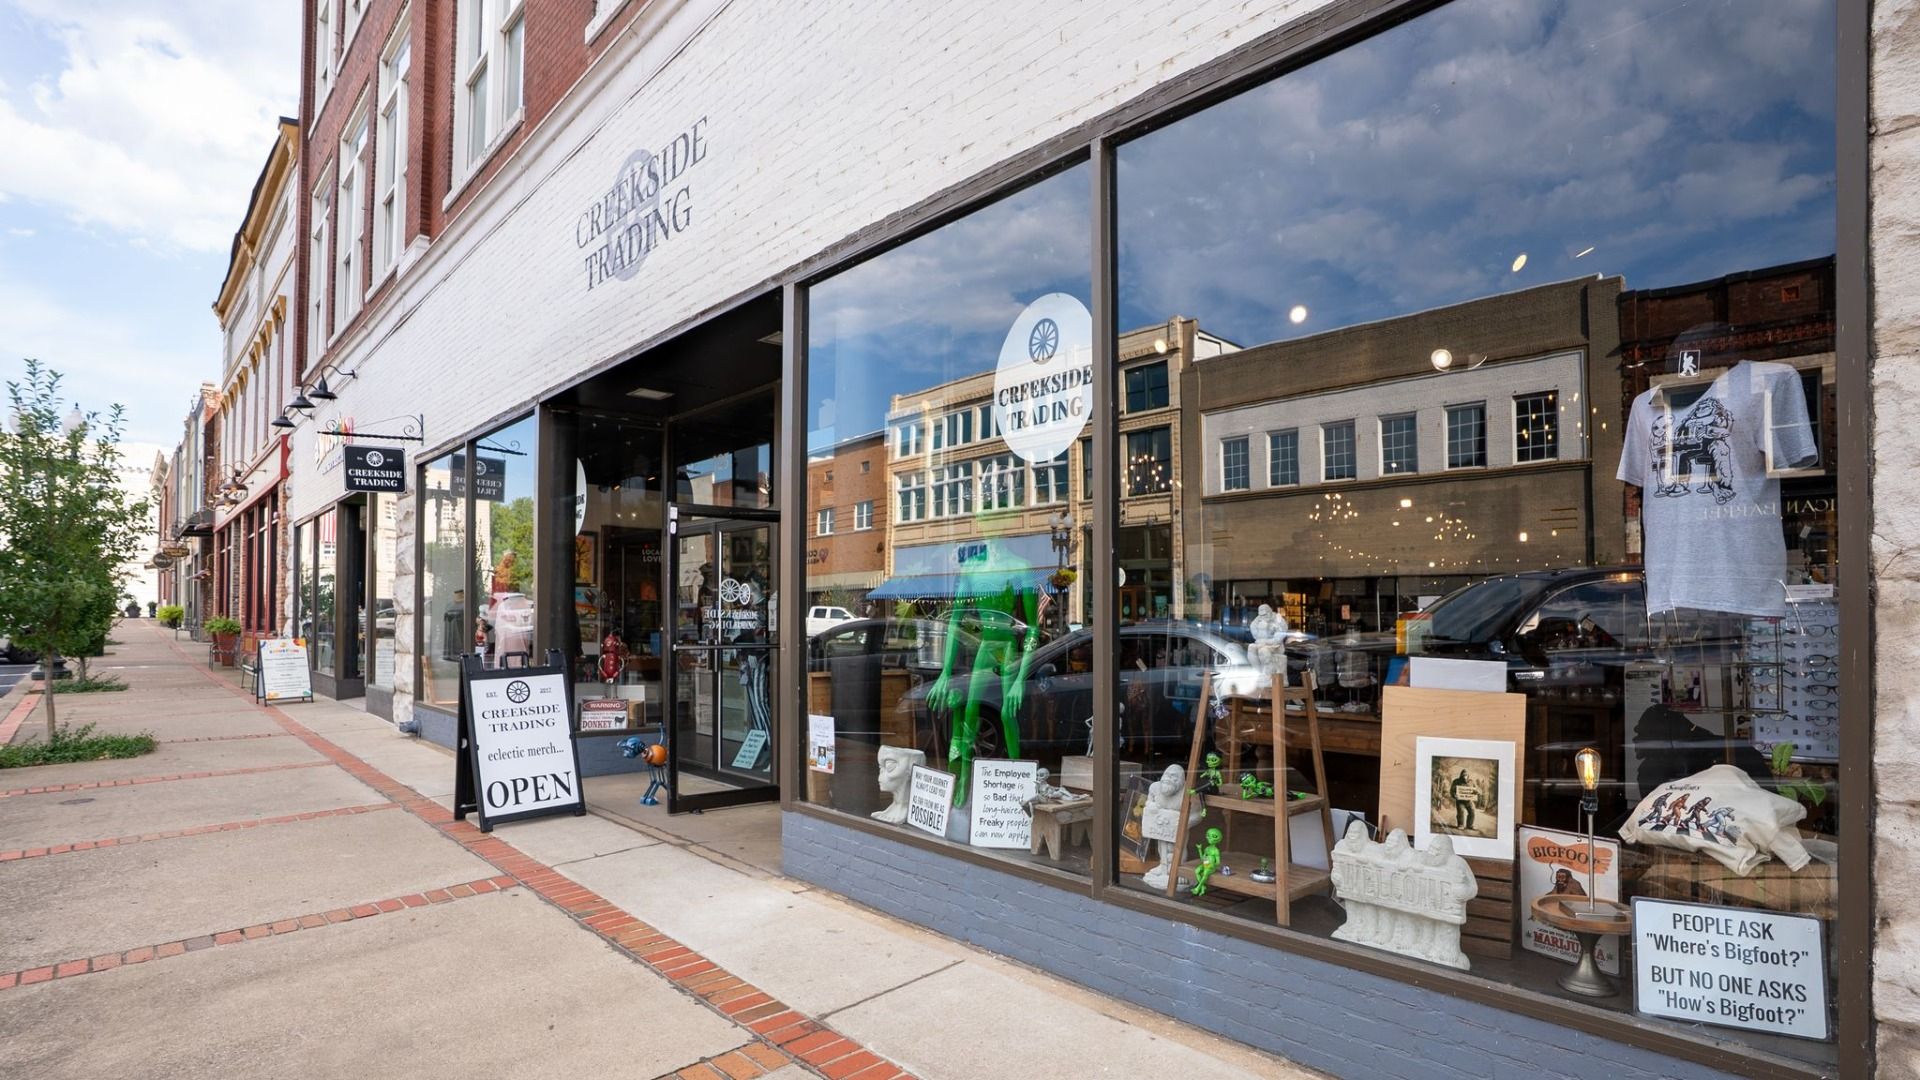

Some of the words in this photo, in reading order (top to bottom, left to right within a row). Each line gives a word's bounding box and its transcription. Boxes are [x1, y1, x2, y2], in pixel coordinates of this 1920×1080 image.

[576, 115, 708, 249] CREEKSIDE
[585, 185, 693, 291] TRADING
[998, 364, 1093, 408] CREEKSIDE
[1006, 396, 1083, 431] TRADING
[348, 468, 403, 479] CREEKSIDE
[353, 478, 398, 487] TRADING
[481, 703, 561, 720] CREEKSIDE
[489, 718, 556, 733] TRADING
[582, 720, 612, 729] DONKEY
[487, 745, 525, 762] eclectic
[528, 741, 565, 758] merch...
[981, 766, 992, 777] The
[994, 768, 1031, 779] Employee
[983, 780, 1016, 792] Shortage
[1017, 782, 1024, 790] is
[487, 771, 572, 809] OPEN
[983, 794, 991, 802] so
[992, 793, 1008, 802] Bad
[910, 804, 944, 832] POSSIBLE!
[979, 817, 1005, 831] Freaky
[1006, 818, 1029, 830] people
[991, 831, 1005, 839] now
[1342, 862, 1455, 910] WELCOME
[1672, 912, 1734, 936] PEOPLE
[1737, 920, 1775, 941] ASK
[1533, 930, 1606, 961] MARIJUA
[1646, 932, 1720, 957] "Where's
[1724, 942, 1809, 967] Bigfoot?"
[1651, 965, 1685, 986] BUT
[1689, 970, 1713, 990] NO
[1718, 974, 1753, 995] ONE
[1758, 979, 1807, 1003] ASKS
[1658, 989, 1716, 1014] "How's
[1720, 998, 1805, 1025] Bigfoot?"
